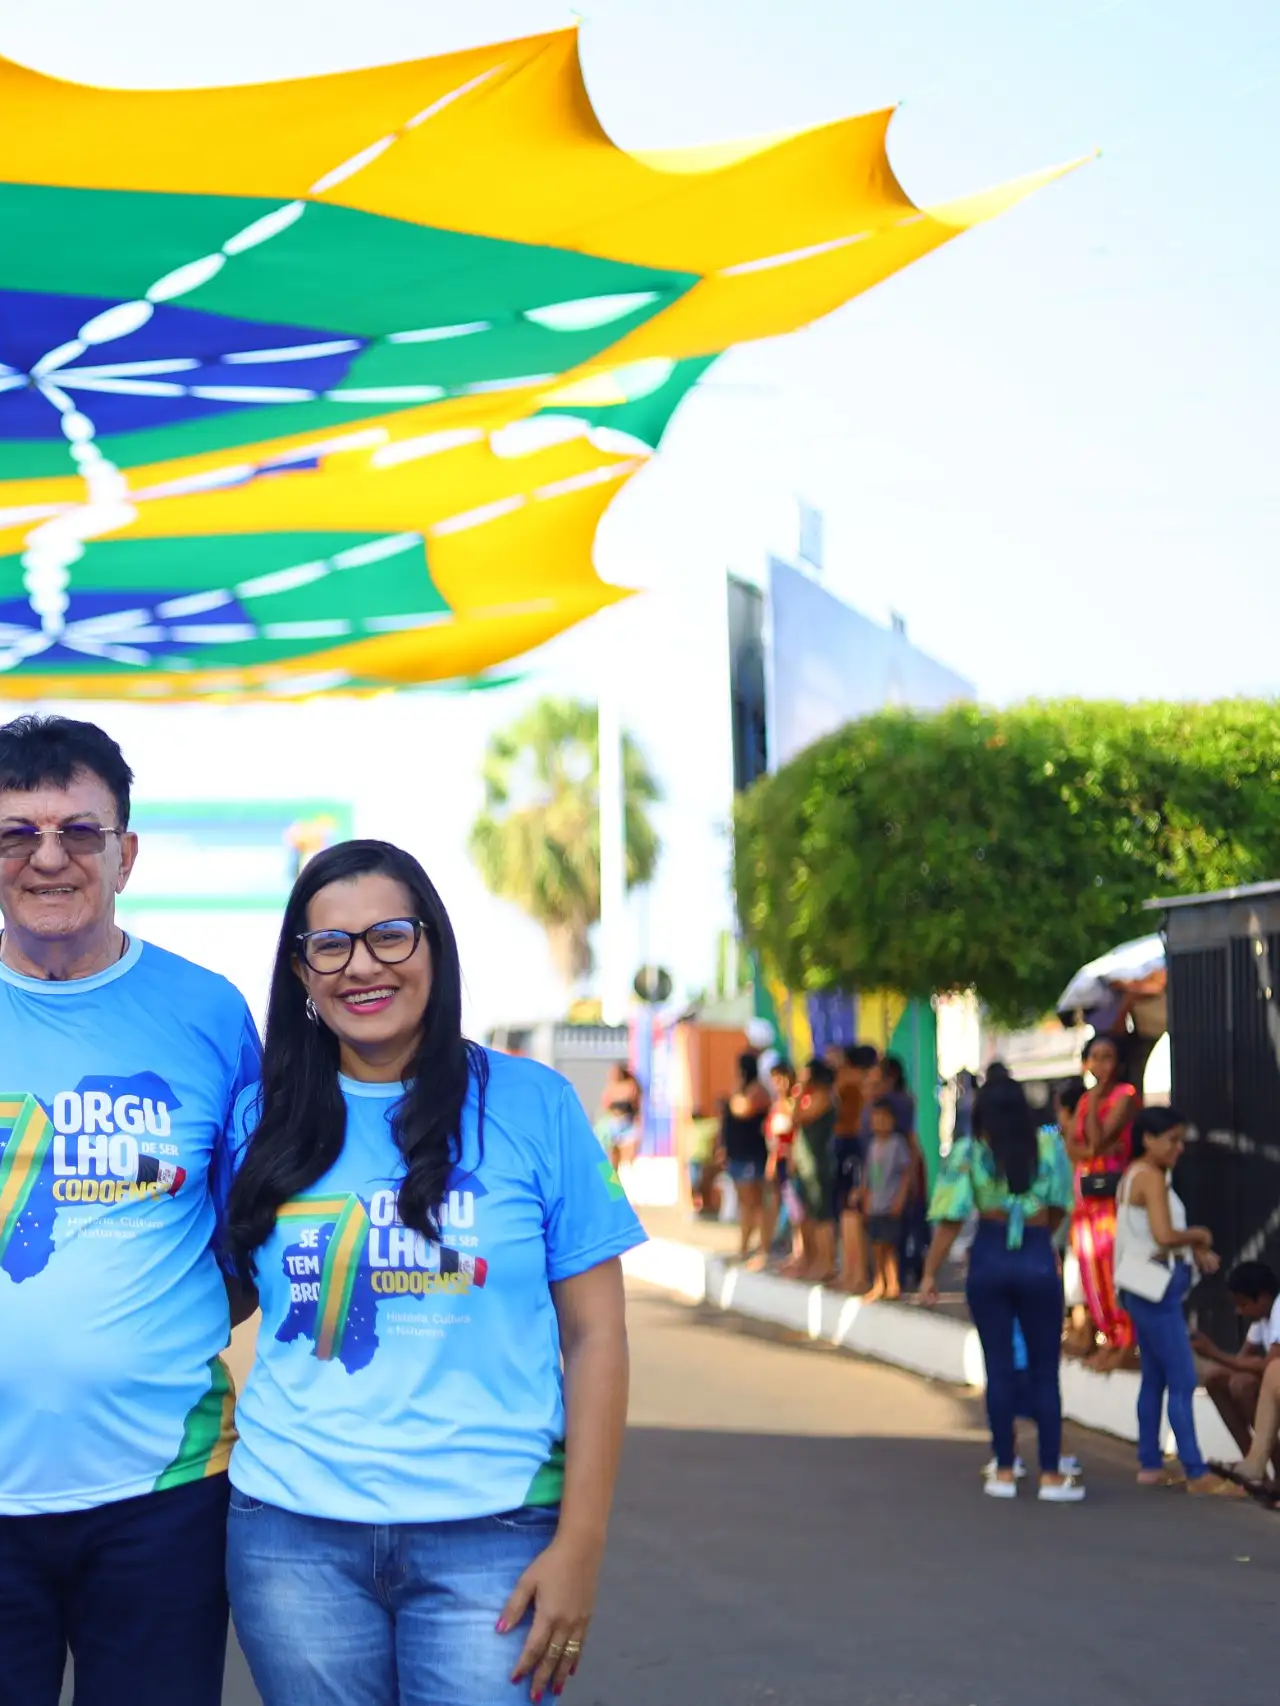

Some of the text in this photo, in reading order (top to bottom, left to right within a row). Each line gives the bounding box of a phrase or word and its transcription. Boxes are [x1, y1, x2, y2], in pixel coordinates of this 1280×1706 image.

[52, 1090, 172, 1136] ORGU
[52, 1134, 139, 1178] LHO
[141, 1141, 180, 1156] DE SER
[299, 1228, 320, 1248] SE
[369, 1227, 441, 1268] LHO
[458, 1235, 480, 1247] SER
[285, 1254, 320, 1276] TEM
[291, 1282, 321, 1303] BRO
[370, 1270, 471, 1295] CODOENSE
